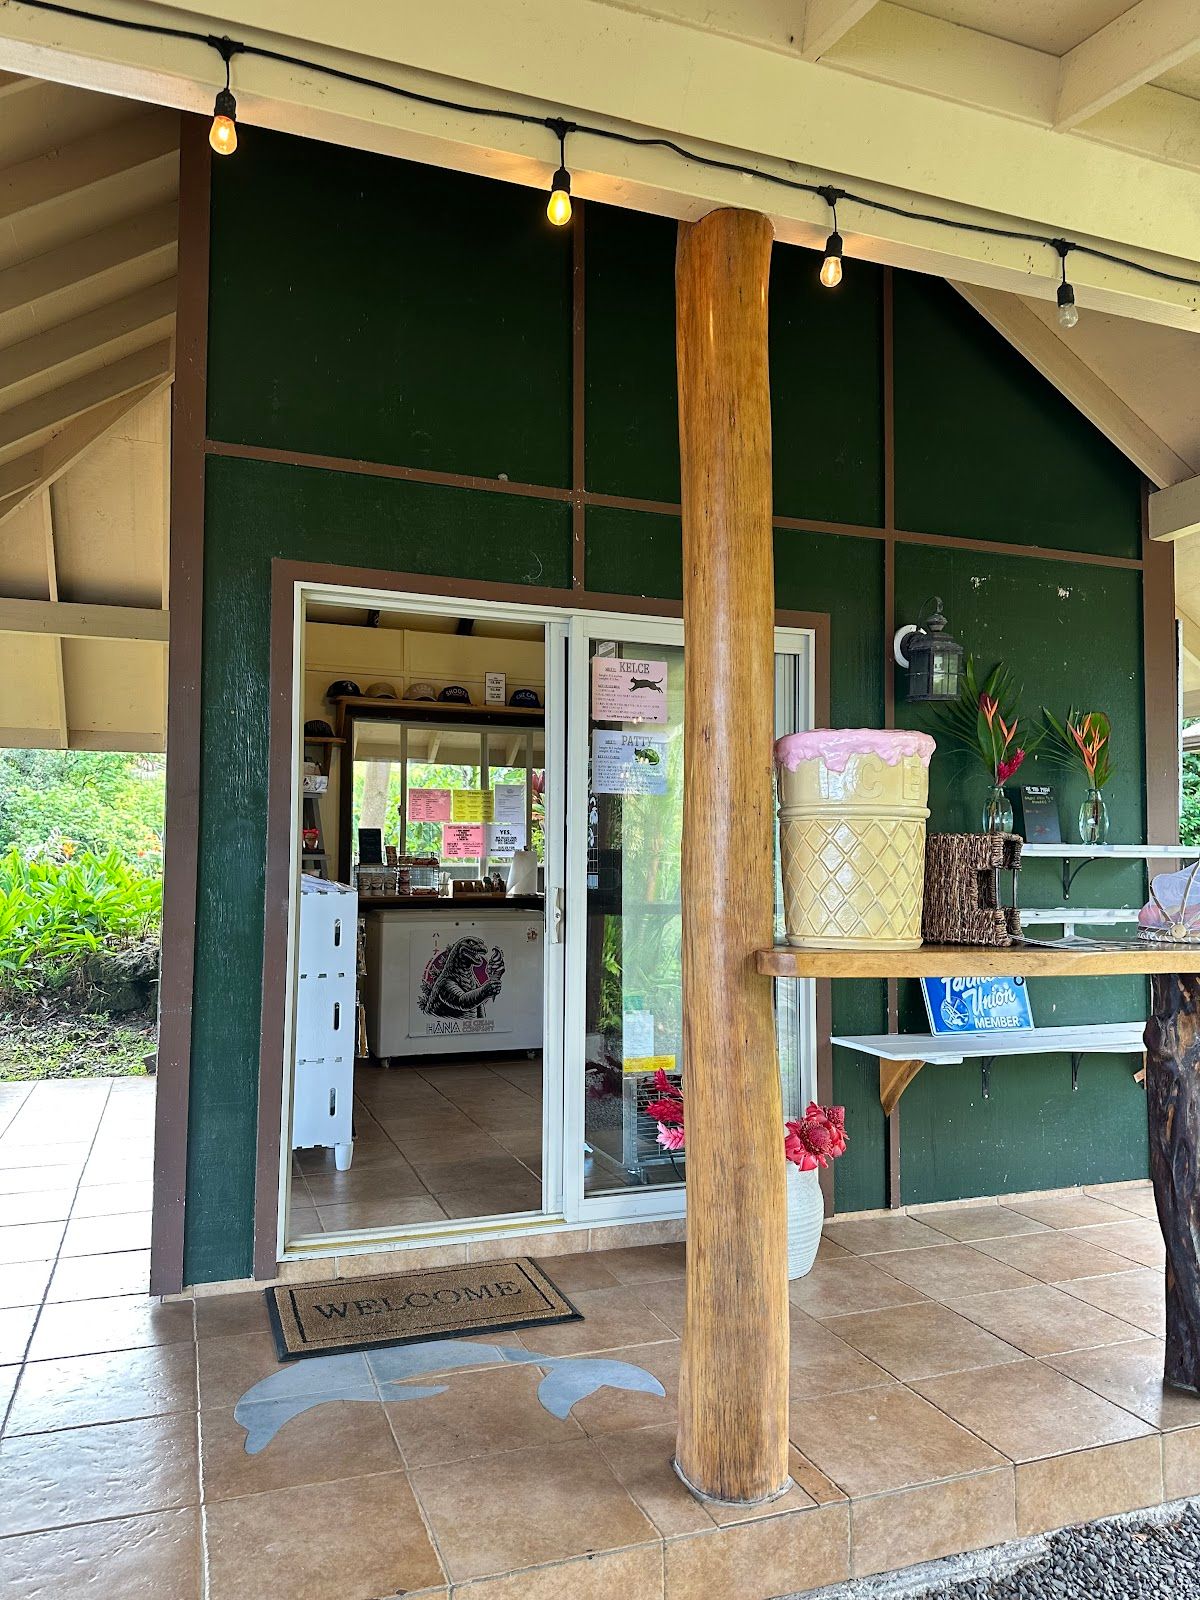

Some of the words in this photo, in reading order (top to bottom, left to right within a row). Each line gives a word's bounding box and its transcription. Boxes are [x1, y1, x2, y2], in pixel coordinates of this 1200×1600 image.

[619, 661, 650, 674] KELCE
[621, 735, 653, 748] PATTY
[962, 983, 1016, 1017] Union
[426, 1020, 461, 1035] HĀNA
[974, 1016, 1020, 1029] MEMBER
[312, 1280, 523, 1320] WELCOME
